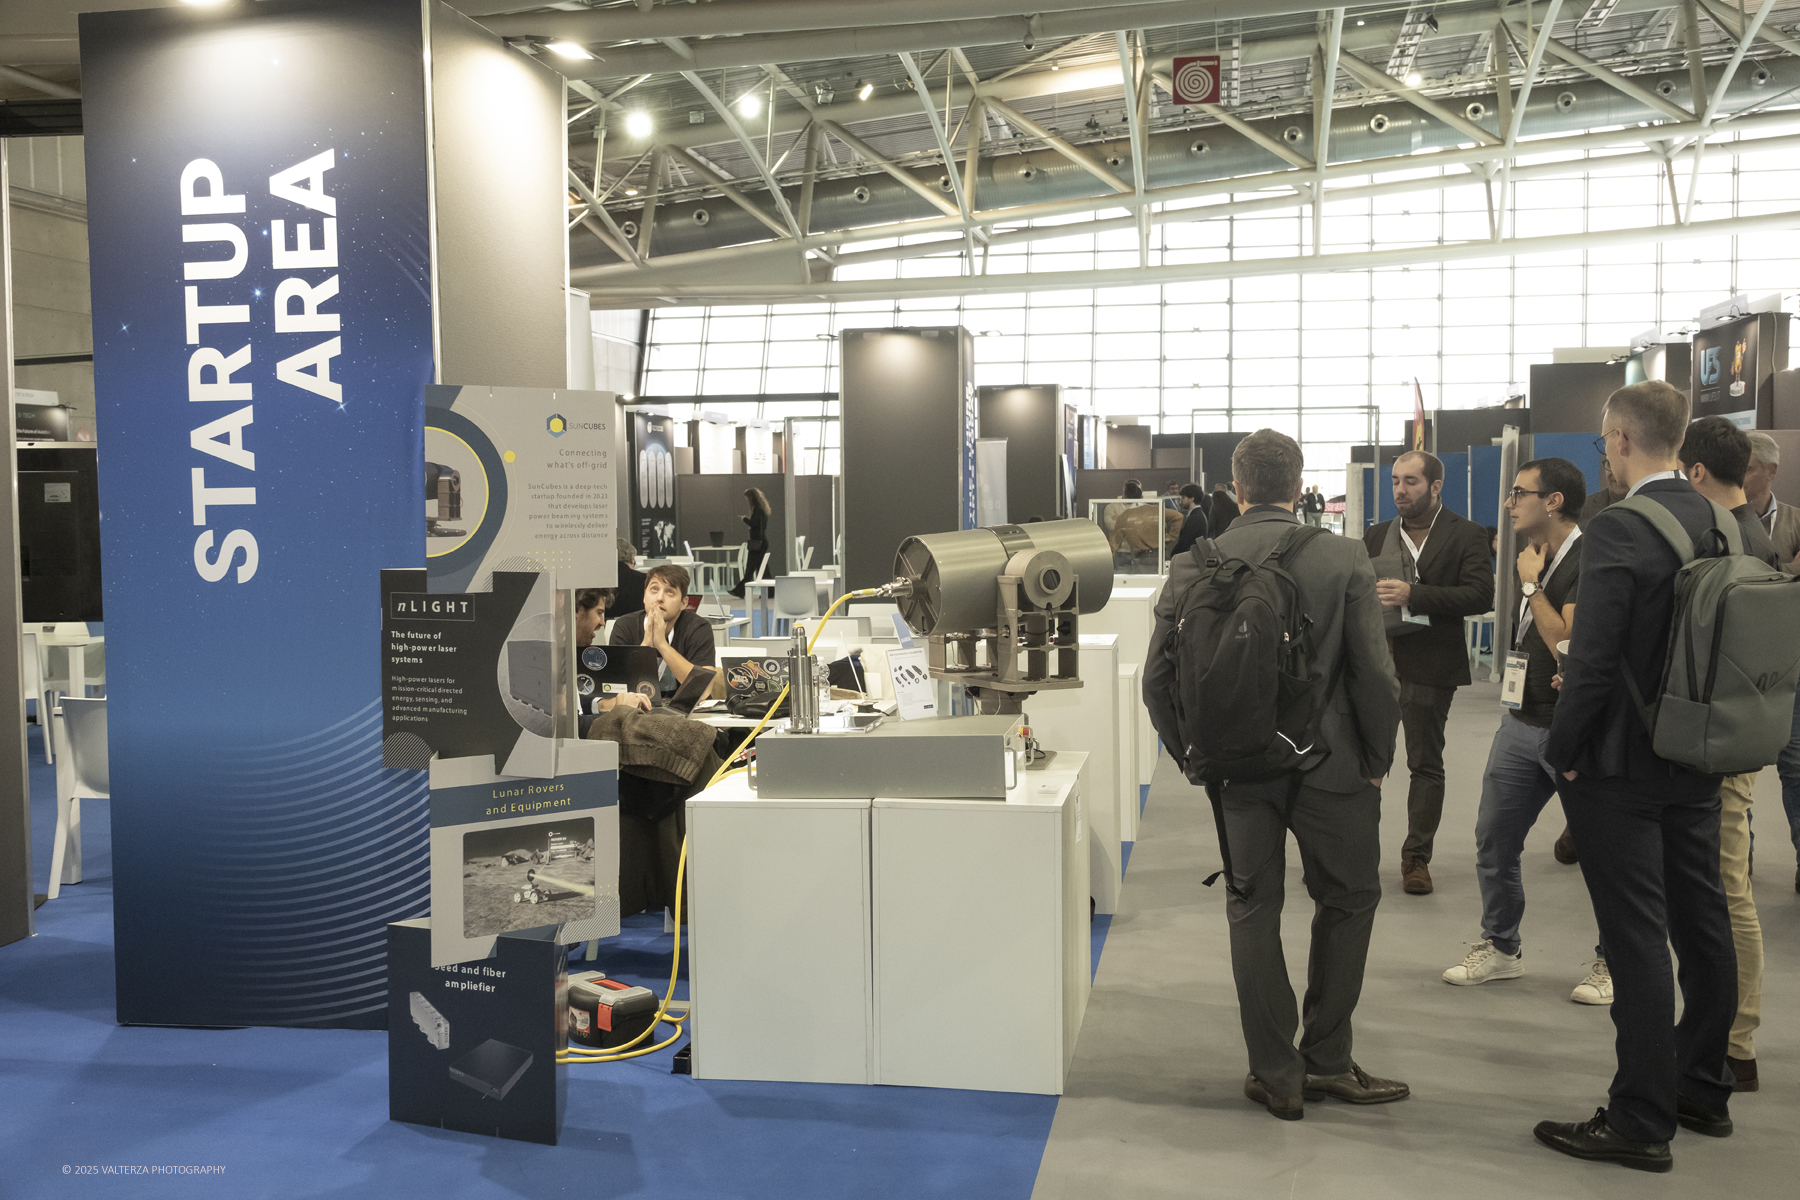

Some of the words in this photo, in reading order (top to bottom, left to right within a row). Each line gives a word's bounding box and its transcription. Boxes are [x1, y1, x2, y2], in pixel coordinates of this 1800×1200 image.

[269, 148, 343, 404] AREA
[179, 158, 259, 584] STARTUP
[559, 449, 607, 458] Connecting
[577, 461, 607, 470] off-grid
[397, 600, 468, 613] nLIGHT
[391, 630, 405, 639] The
[391, 643, 436, 653] high-power
[391, 656, 423, 664] systems
[392, 676, 427, 684] High-power
[422, 707, 468, 715] manufacturing
[492, 787, 525, 799] Lunar
[528, 783, 565, 794] Rovers
[486, 804, 507, 815] and
[511, 798, 571, 812] Equipment
[461, 966, 479, 975] and
[483, 966, 506, 978] fiber
[445, 980, 495, 992] ampliefier
